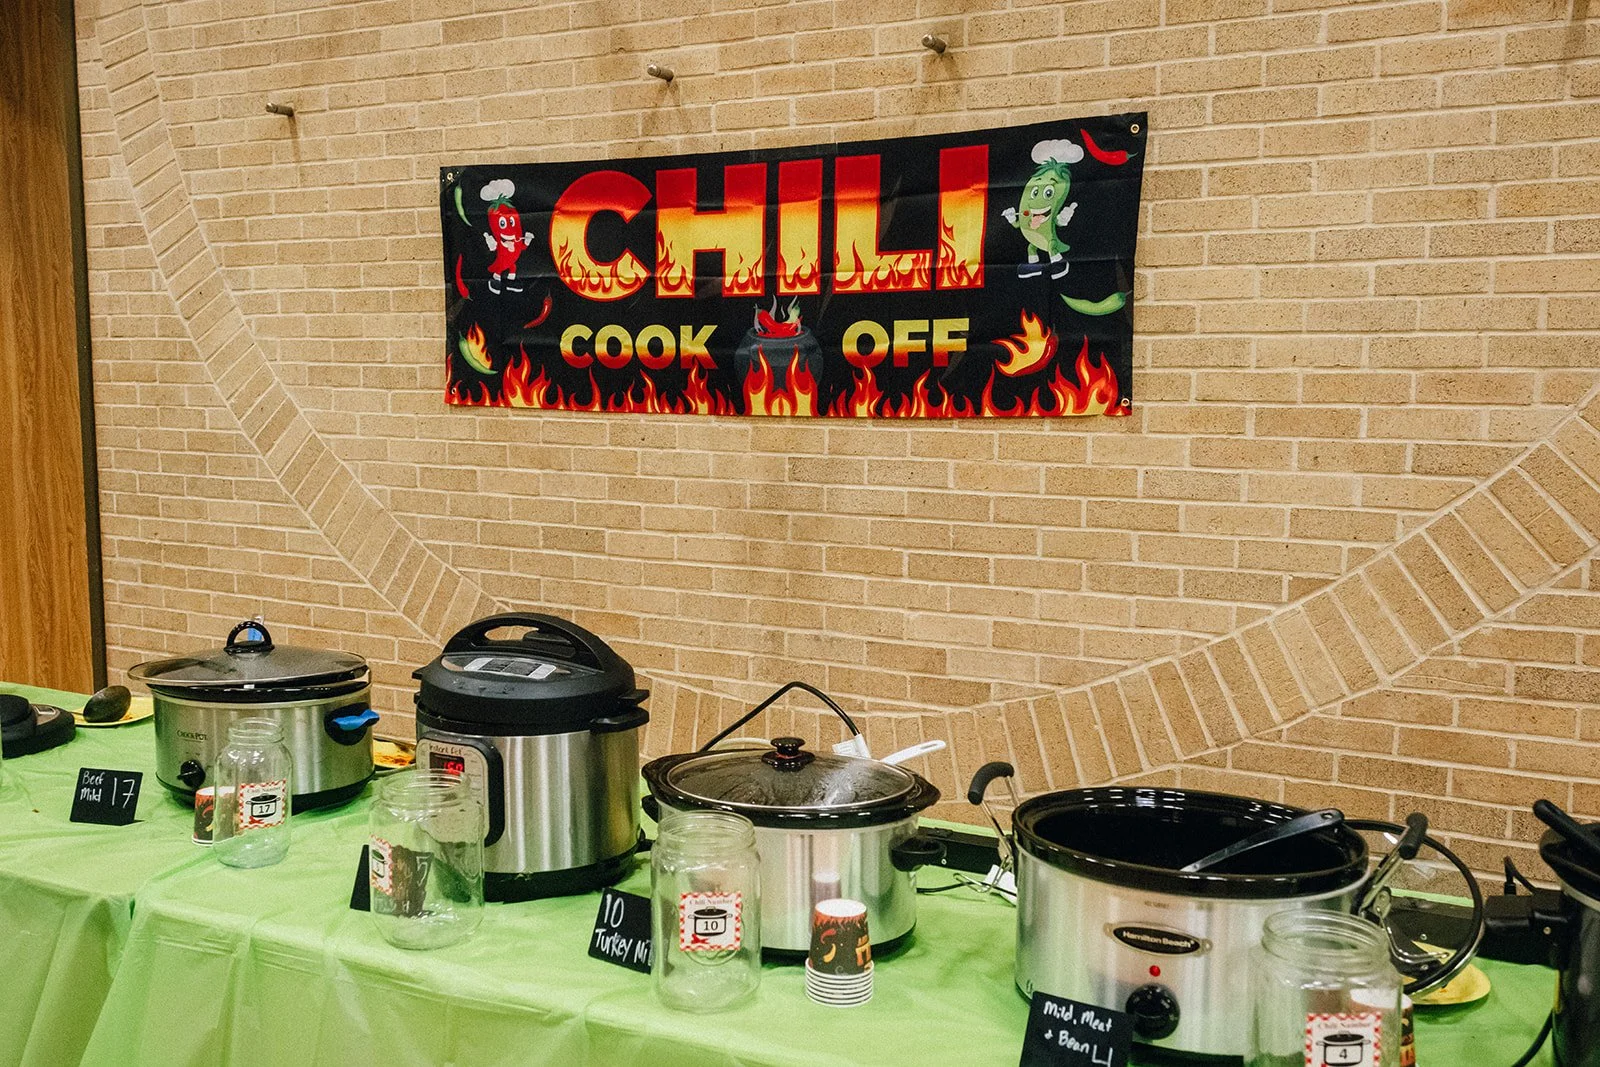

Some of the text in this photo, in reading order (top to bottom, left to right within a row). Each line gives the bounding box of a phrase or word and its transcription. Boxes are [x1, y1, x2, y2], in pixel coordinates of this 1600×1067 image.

[547, 144, 990, 301] CHILI
[559, 317, 970, 371] COOK OFF
[82, 770, 106, 786] Beef
[80, 787, 102, 803] Mild
[111, 777, 136, 809] 17
[258, 804, 271, 814] 17
[604, 893, 625, 928] 10
[703, 920, 719, 931] 10
[595, 928, 633, 962] Turkey
[1081, 1010, 1113, 1033] Meat
[1058, 1030, 1090, 1053] Bean
[1338, 1048, 1348, 1059] 4
